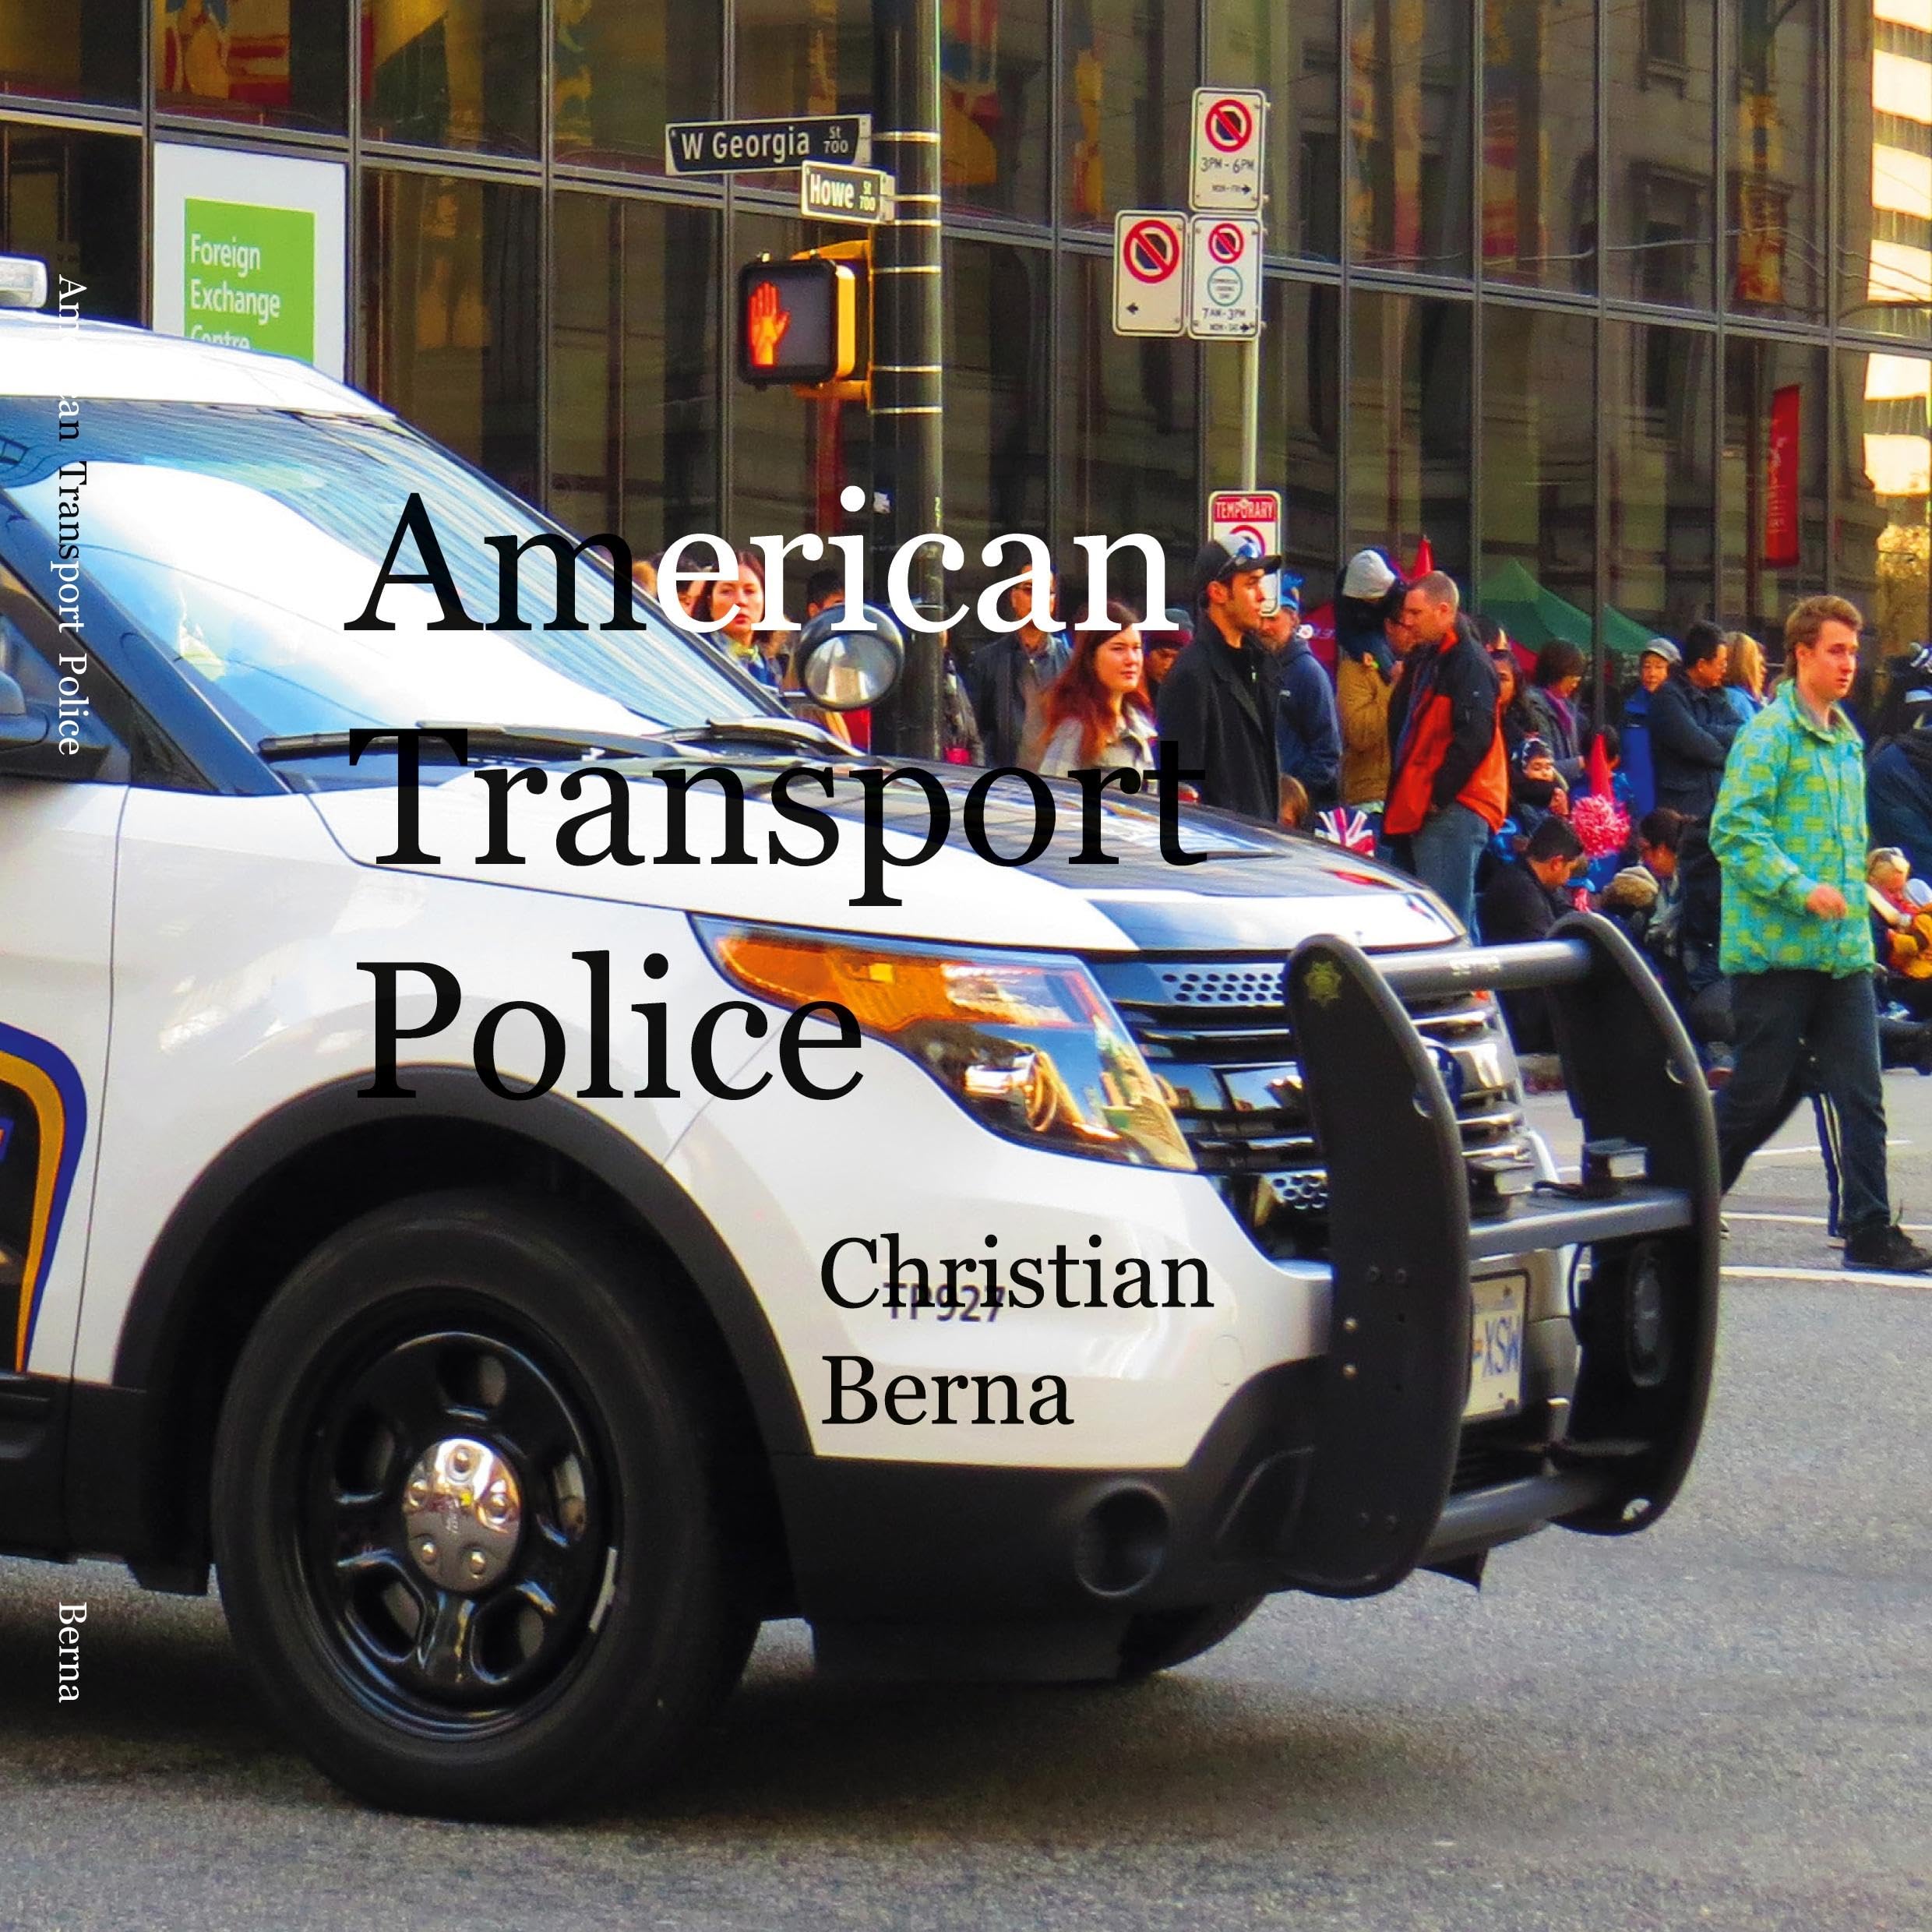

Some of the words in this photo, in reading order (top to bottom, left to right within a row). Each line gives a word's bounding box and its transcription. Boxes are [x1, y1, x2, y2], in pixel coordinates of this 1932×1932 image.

[682, 132, 703, 160] W
[712, 125, 810, 164] Georgia
[823, 140, 849, 154] 700
[829, 125, 841, 139] St
[810, 173, 855, 209] Howe
[190, 233, 261, 278] Foreign
[190, 278, 281, 326] Exchange
[1215, 501, 1274, 520] TEMPORARY
[883, 1282, 1006, 1323] TP927
